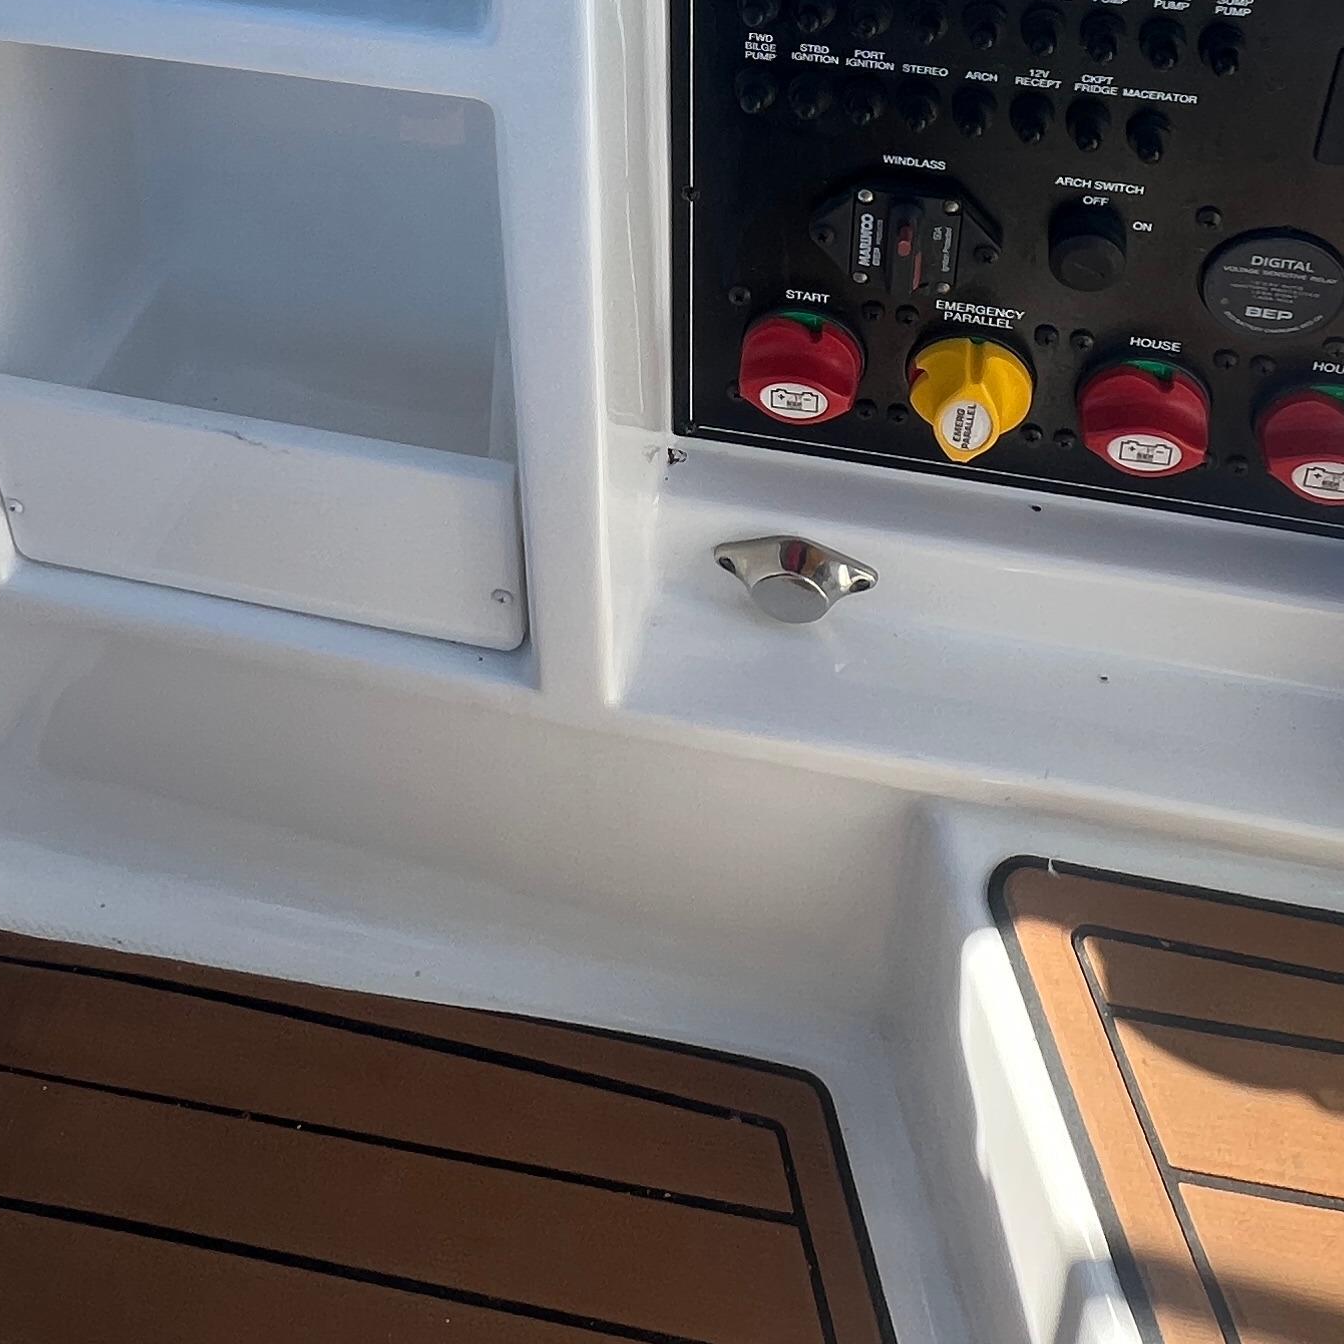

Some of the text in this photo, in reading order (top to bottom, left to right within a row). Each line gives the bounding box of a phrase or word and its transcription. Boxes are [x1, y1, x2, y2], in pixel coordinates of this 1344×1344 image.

[1154, 0, 1190, 10] PUMP
[1215, 6, 1251, 17] PUMP
[748, 33, 773, 42] FWD
[745, 42, 776, 52] BILGE
[800, 44, 829, 54] STBD
[745, 51, 776, 61] PUMP
[791, 52, 839, 65] IGNITION
[854, 50, 885, 60] PORT
[845, 58, 895, 71] IGNITION
[902, 64, 948, 77] STEREO
[965, 71, 997, 82] ARCH
[1030, 69, 1050, 78] 12V
[1082, 74, 1113, 85] CKPT
[1015, 76, 1061, 89] RECEPT
[1074, 83, 1118, 95] FRIDGE
[1122, 88, 1198, 104] MACERATOR
[883, 155, 946, 170] WINDLASS
[1055, 177, 1145, 195] ARCH SWITCH
[1083, 196, 1109, 206] OFF
[1133, 221, 1152, 232] ON
[1251, 255, 1314, 273] DIGITAL
[786, 289, 830, 304] START
[936, 300, 1025, 321] EMERGENCY
[1245, 306, 1293, 321] BEP
[944, 311, 1013, 330] PARALLEL
[1130, 337, 1181, 353] HOUSE
[953, 408, 966, 442] EMERG
[962, 404, 977, 449] PARALLEL
